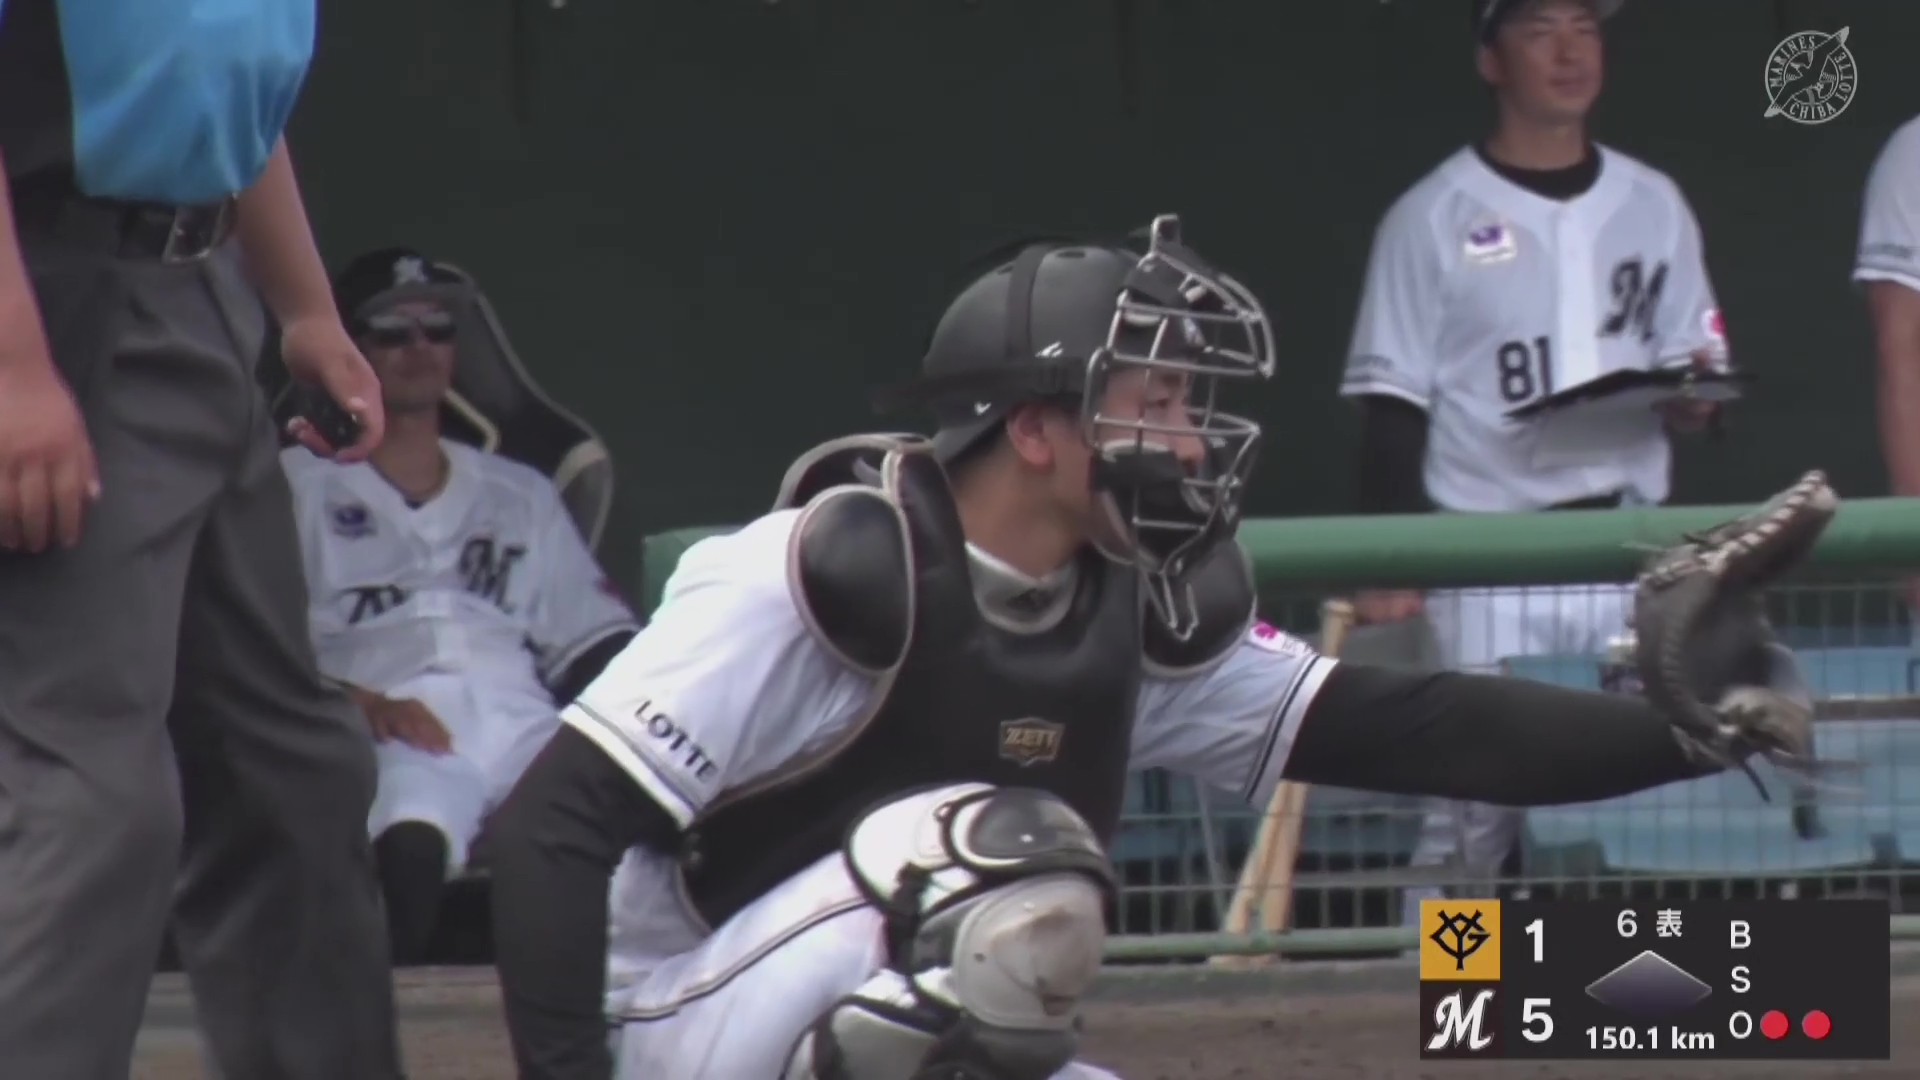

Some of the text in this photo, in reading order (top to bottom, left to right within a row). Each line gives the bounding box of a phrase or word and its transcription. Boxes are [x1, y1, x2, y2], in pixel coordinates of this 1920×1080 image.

[1598, 258, 1669, 342] M
[1498, 335, 1553, 403] 81
[634, 699, 718, 782] LOTTE
